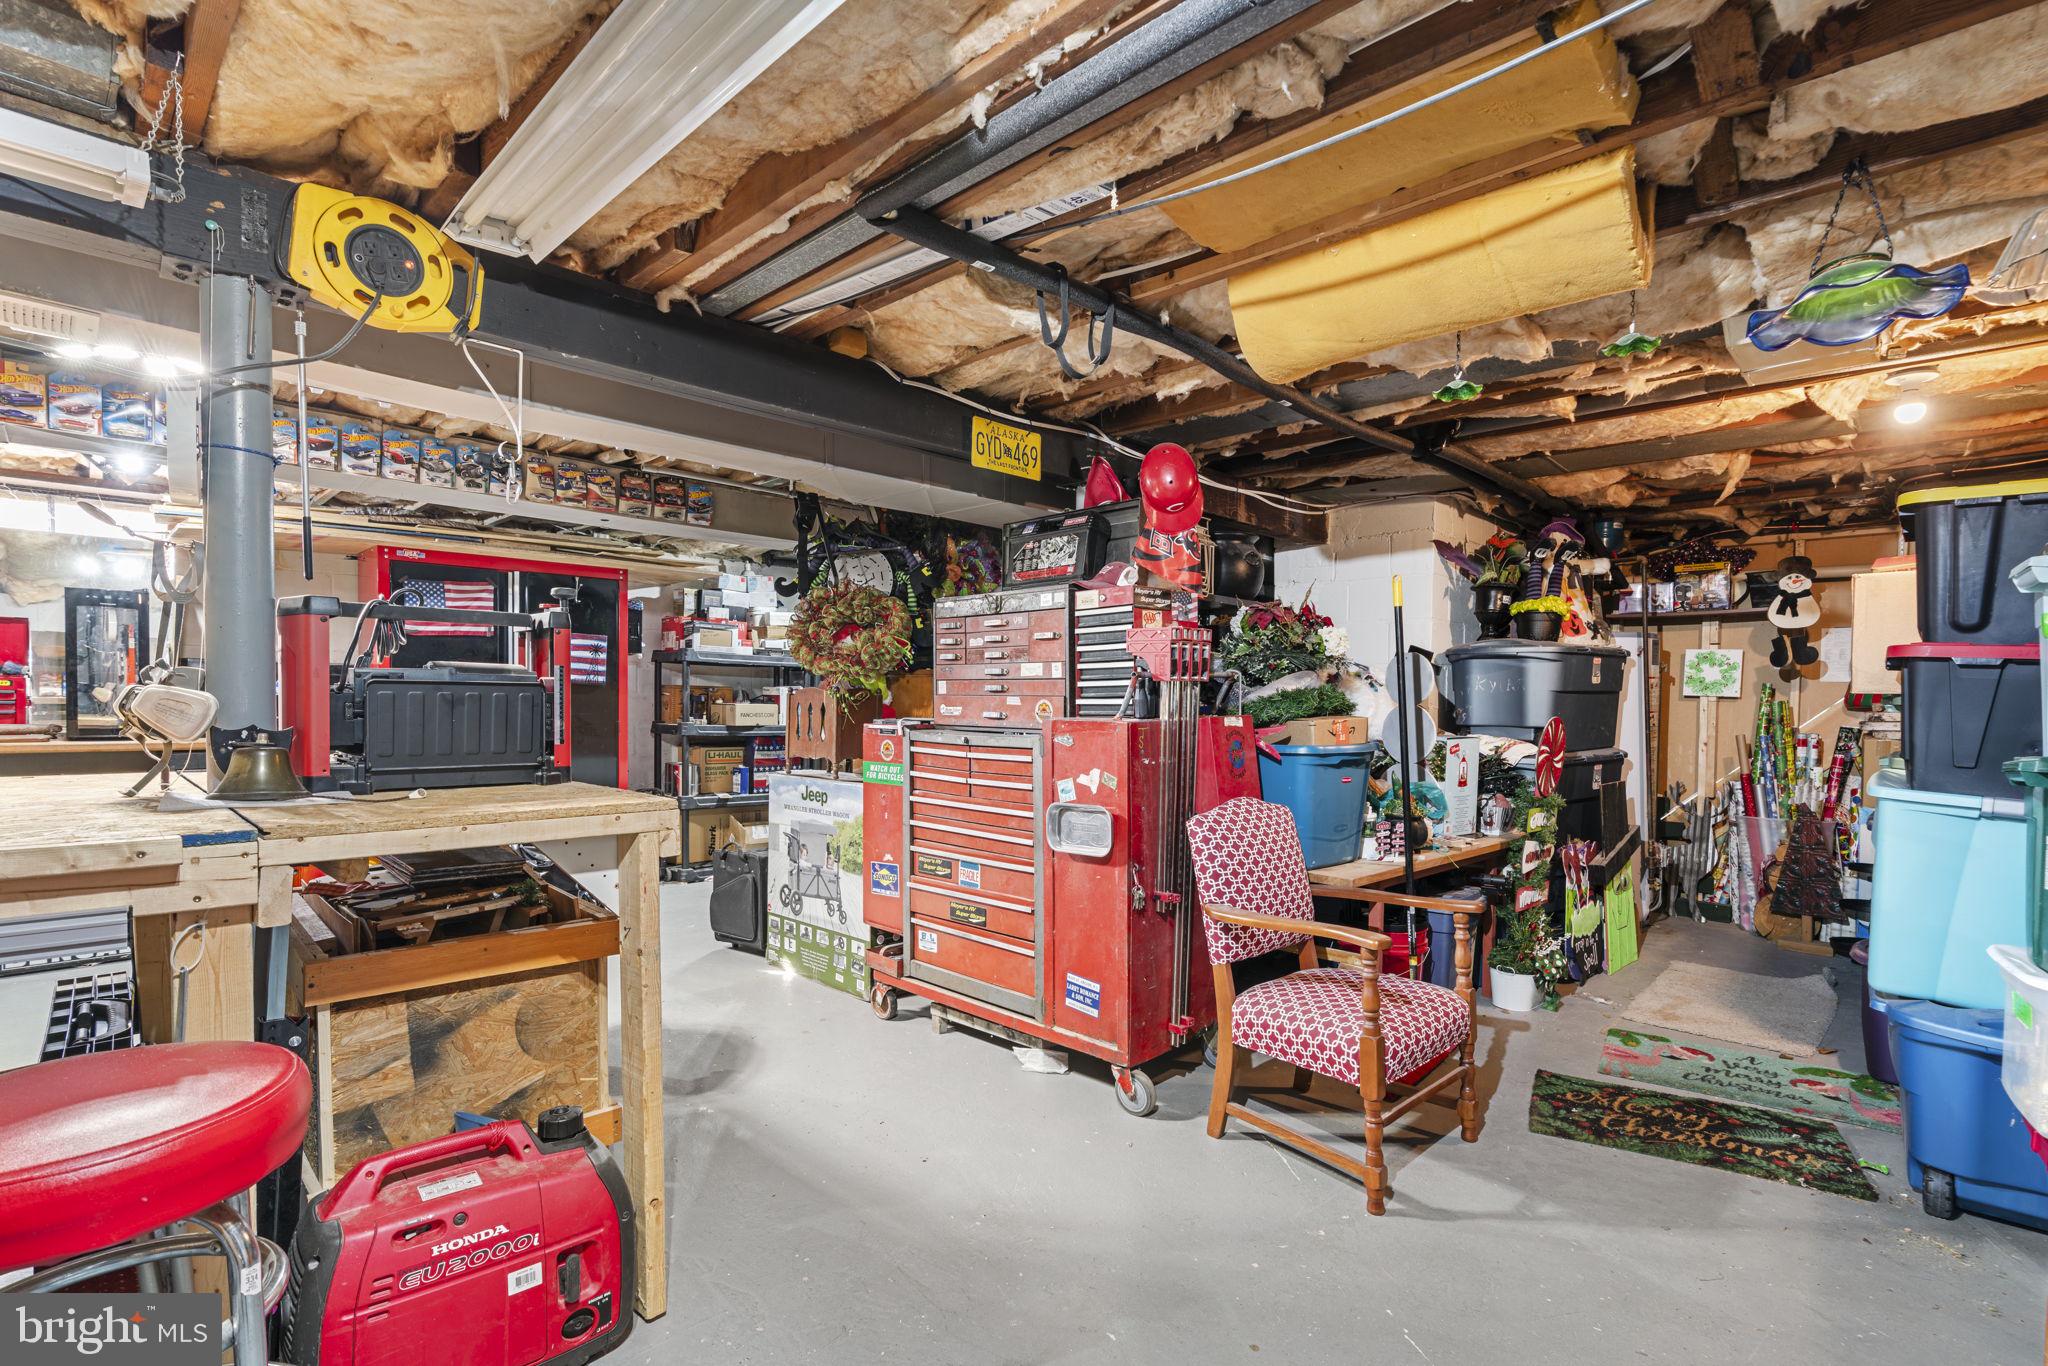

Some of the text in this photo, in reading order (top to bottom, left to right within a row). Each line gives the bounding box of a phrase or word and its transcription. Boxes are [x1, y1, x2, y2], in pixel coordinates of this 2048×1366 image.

[990, 425, 1025, 443] ALASKA
[976, 431, 1038, 469] GYD 469
[708, 751, 742, 759] U-HAUL
[866, 771, 904, 782] FOR BICYCLES
[870, 765, 888, 773] WATCH
[801, 785, 828, 806] Jeep
[783, 803, 850, 819] WRANGLER STROLLER WAGON
[708, 825, 717, 856] Shark
[874, 873, 897, 883] SUNOCO
[960, 869, 980, 882] FRAGILE
[1583, 943, 1599, 974] Spell
[431, 1224, 510, 1257] HONDA
[399, 1232, 540, 1291] EU2000i
